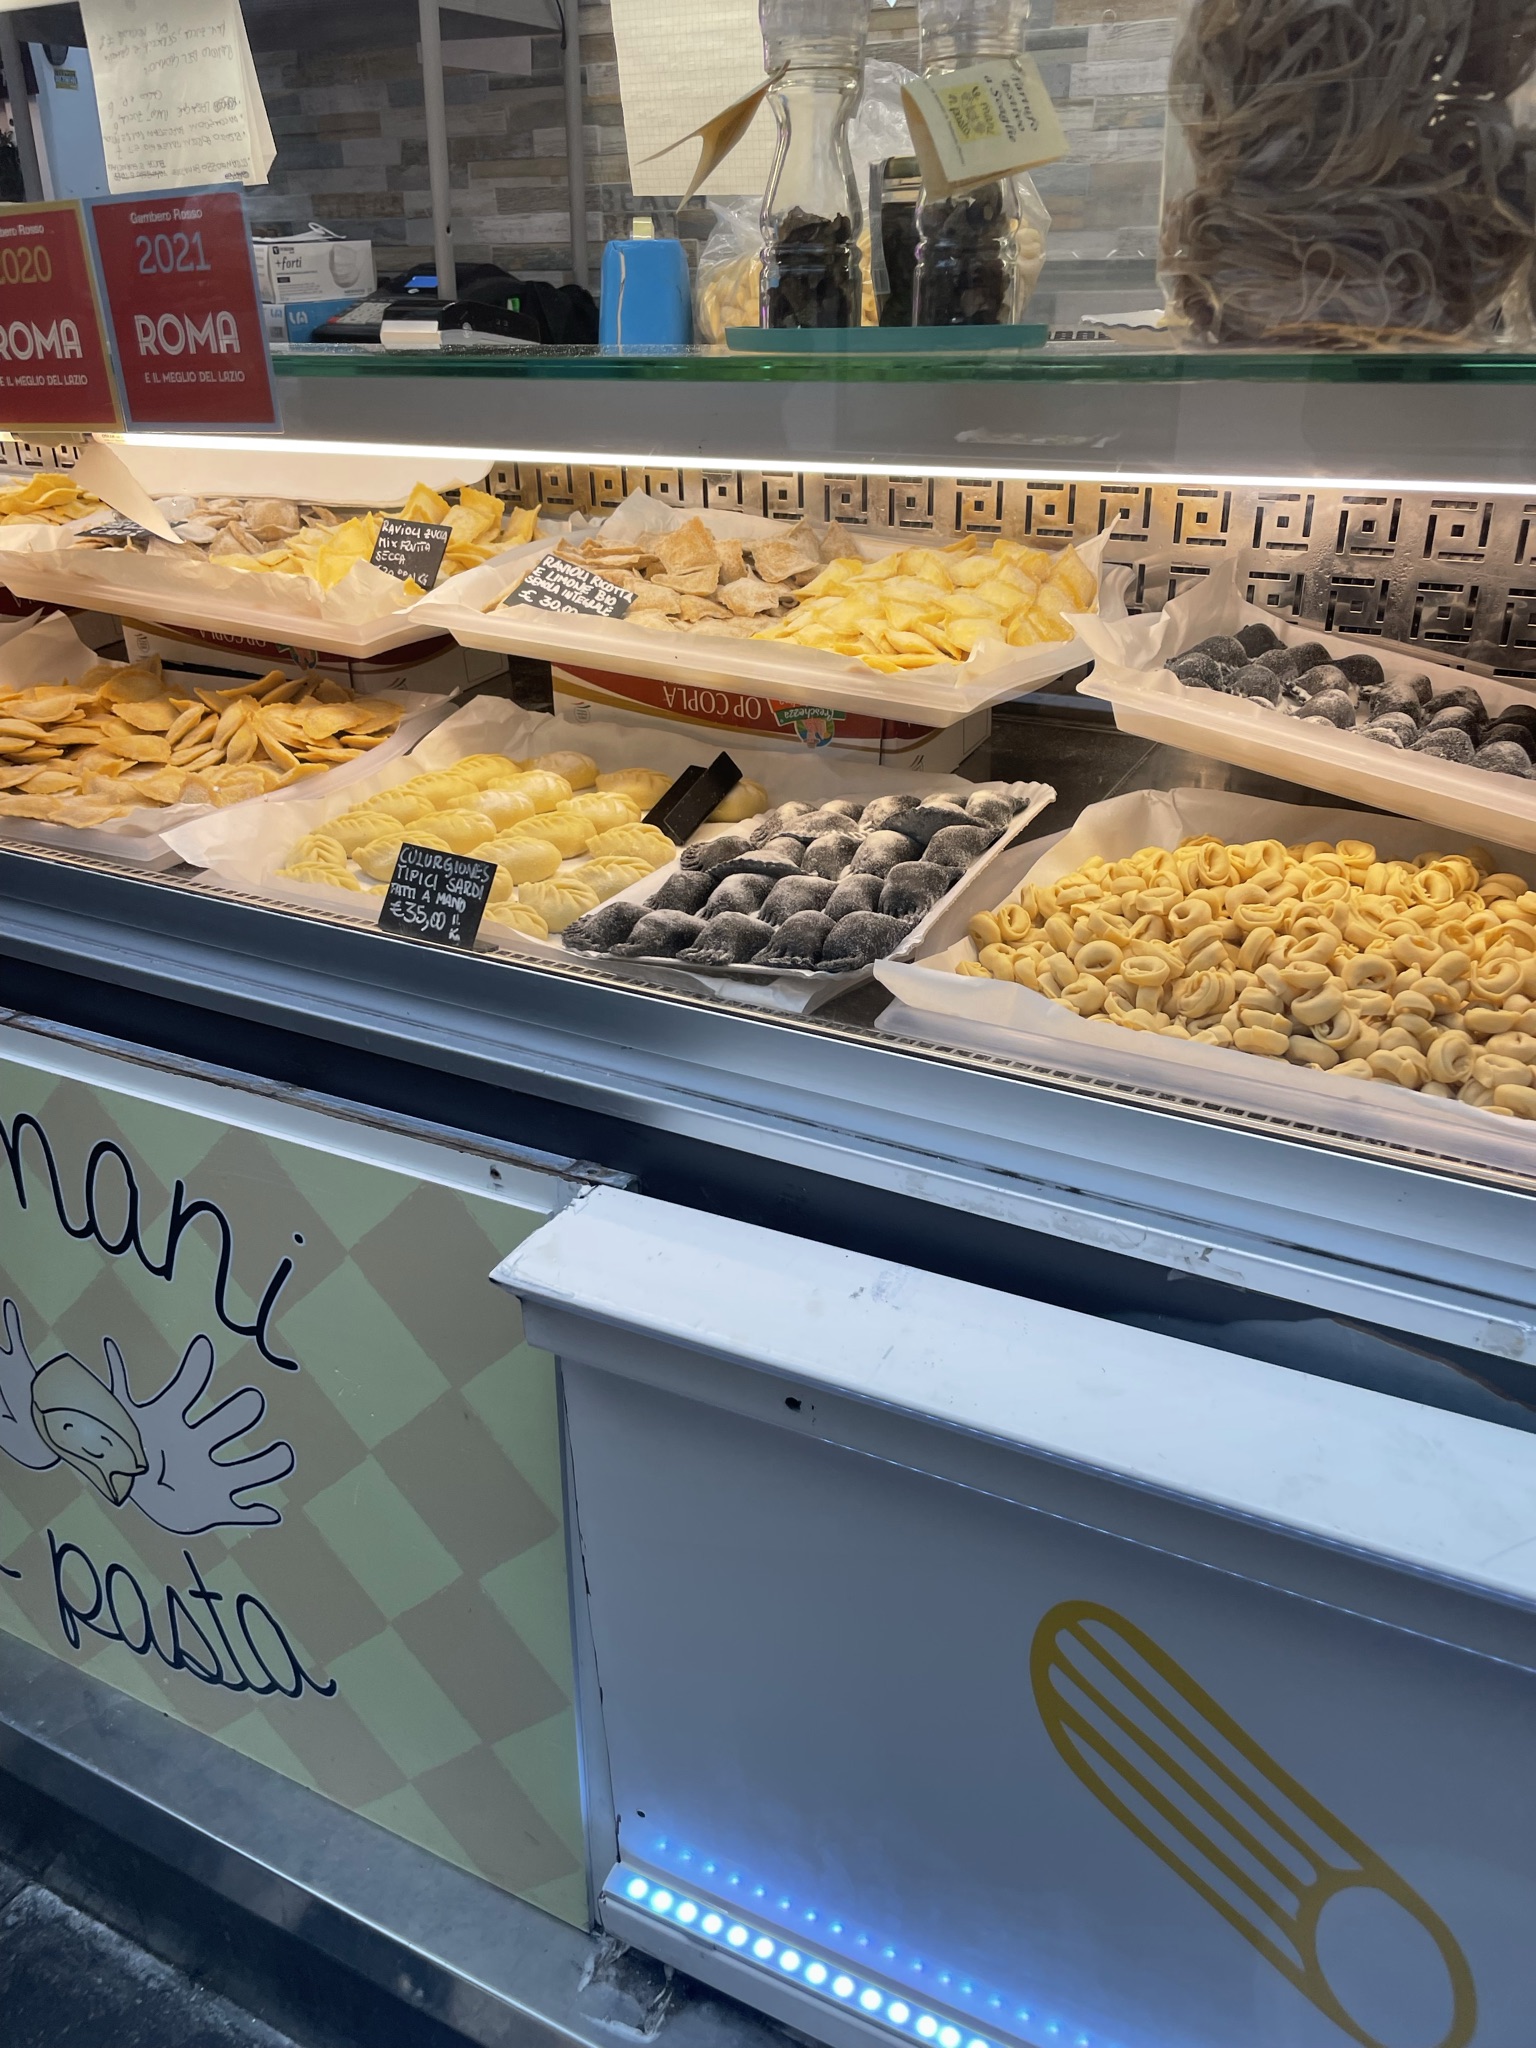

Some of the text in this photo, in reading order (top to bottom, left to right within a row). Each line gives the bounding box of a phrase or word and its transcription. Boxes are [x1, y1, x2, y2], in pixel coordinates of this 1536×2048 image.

[18, 223, 45, 236] Rosso
[130, 208, 204, 224] Gambero Rosso
[135, 230, 212, 276] 2021
[134, 310, 241, 356] ROMA
[6, 376, 14, 387] IL
[15, 375, 45, 387] MEGLIO
[47, 375, 64, 387] DEL
[64, 374, 88, 386] LAZIO
[144, 370, 246, 384] E IL MEGLIO DEL LAZIO
[381, 519, 421, 539] RAVIOLI
[375, 550, 406, 565] SECCA
[524, 575, 615, 617] SEMOLA INTEGRALE
[532, 566, 617, 606] E LIMONE BIO
[542, 556, 634, 604] RAVIOLI RICOTTA
[663, 685, 762, 721] OP COPLA
[397, 863, 485, 900] TIPICI SARDI
[399, 847, 490, 883] CULURGIONES
[389, 900, 447, 932] €35,00
[390, 882, 467, 914] FATTI A MANO
[47, 1528, 338, 1700] pasta
